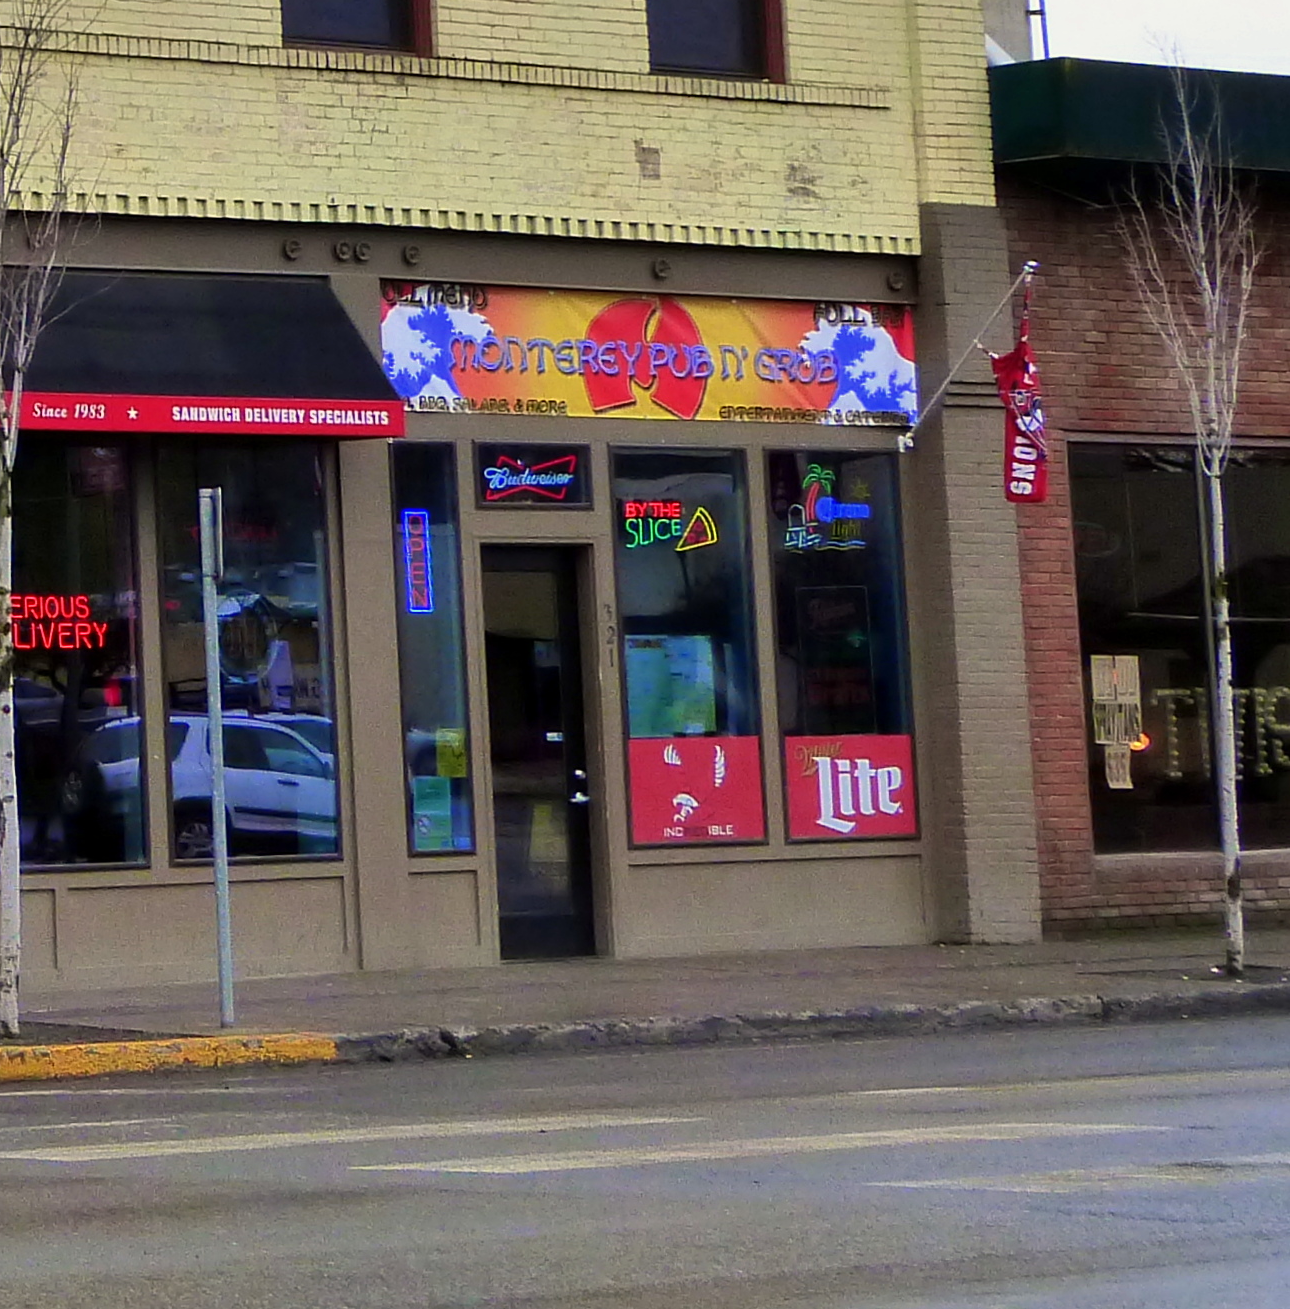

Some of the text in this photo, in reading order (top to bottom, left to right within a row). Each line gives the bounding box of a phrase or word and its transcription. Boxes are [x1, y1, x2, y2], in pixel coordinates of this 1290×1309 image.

[448, 334, 643, 376] MONTEREY
[648, 342, 715, 379] PUB
[754, 347, 839, 384] GRUB
[31, 401, 68, 419] Since
[73, 403, 106, 420] 1983
[171, 405, 390, 426] SANDWICH DELIVERY SPECIALISTS
[483, 465, 574, 490] Budweiser
[624, 501, 681, 519] BY THE
[624, 518, 682, 549] SLICE
[408, 514, 429, 608] OPEN
[9, 595, 91, 620] ERIOUS
[811, 756, 904, 834] Lite
[663, 824, 735, 838] INCIBLE
